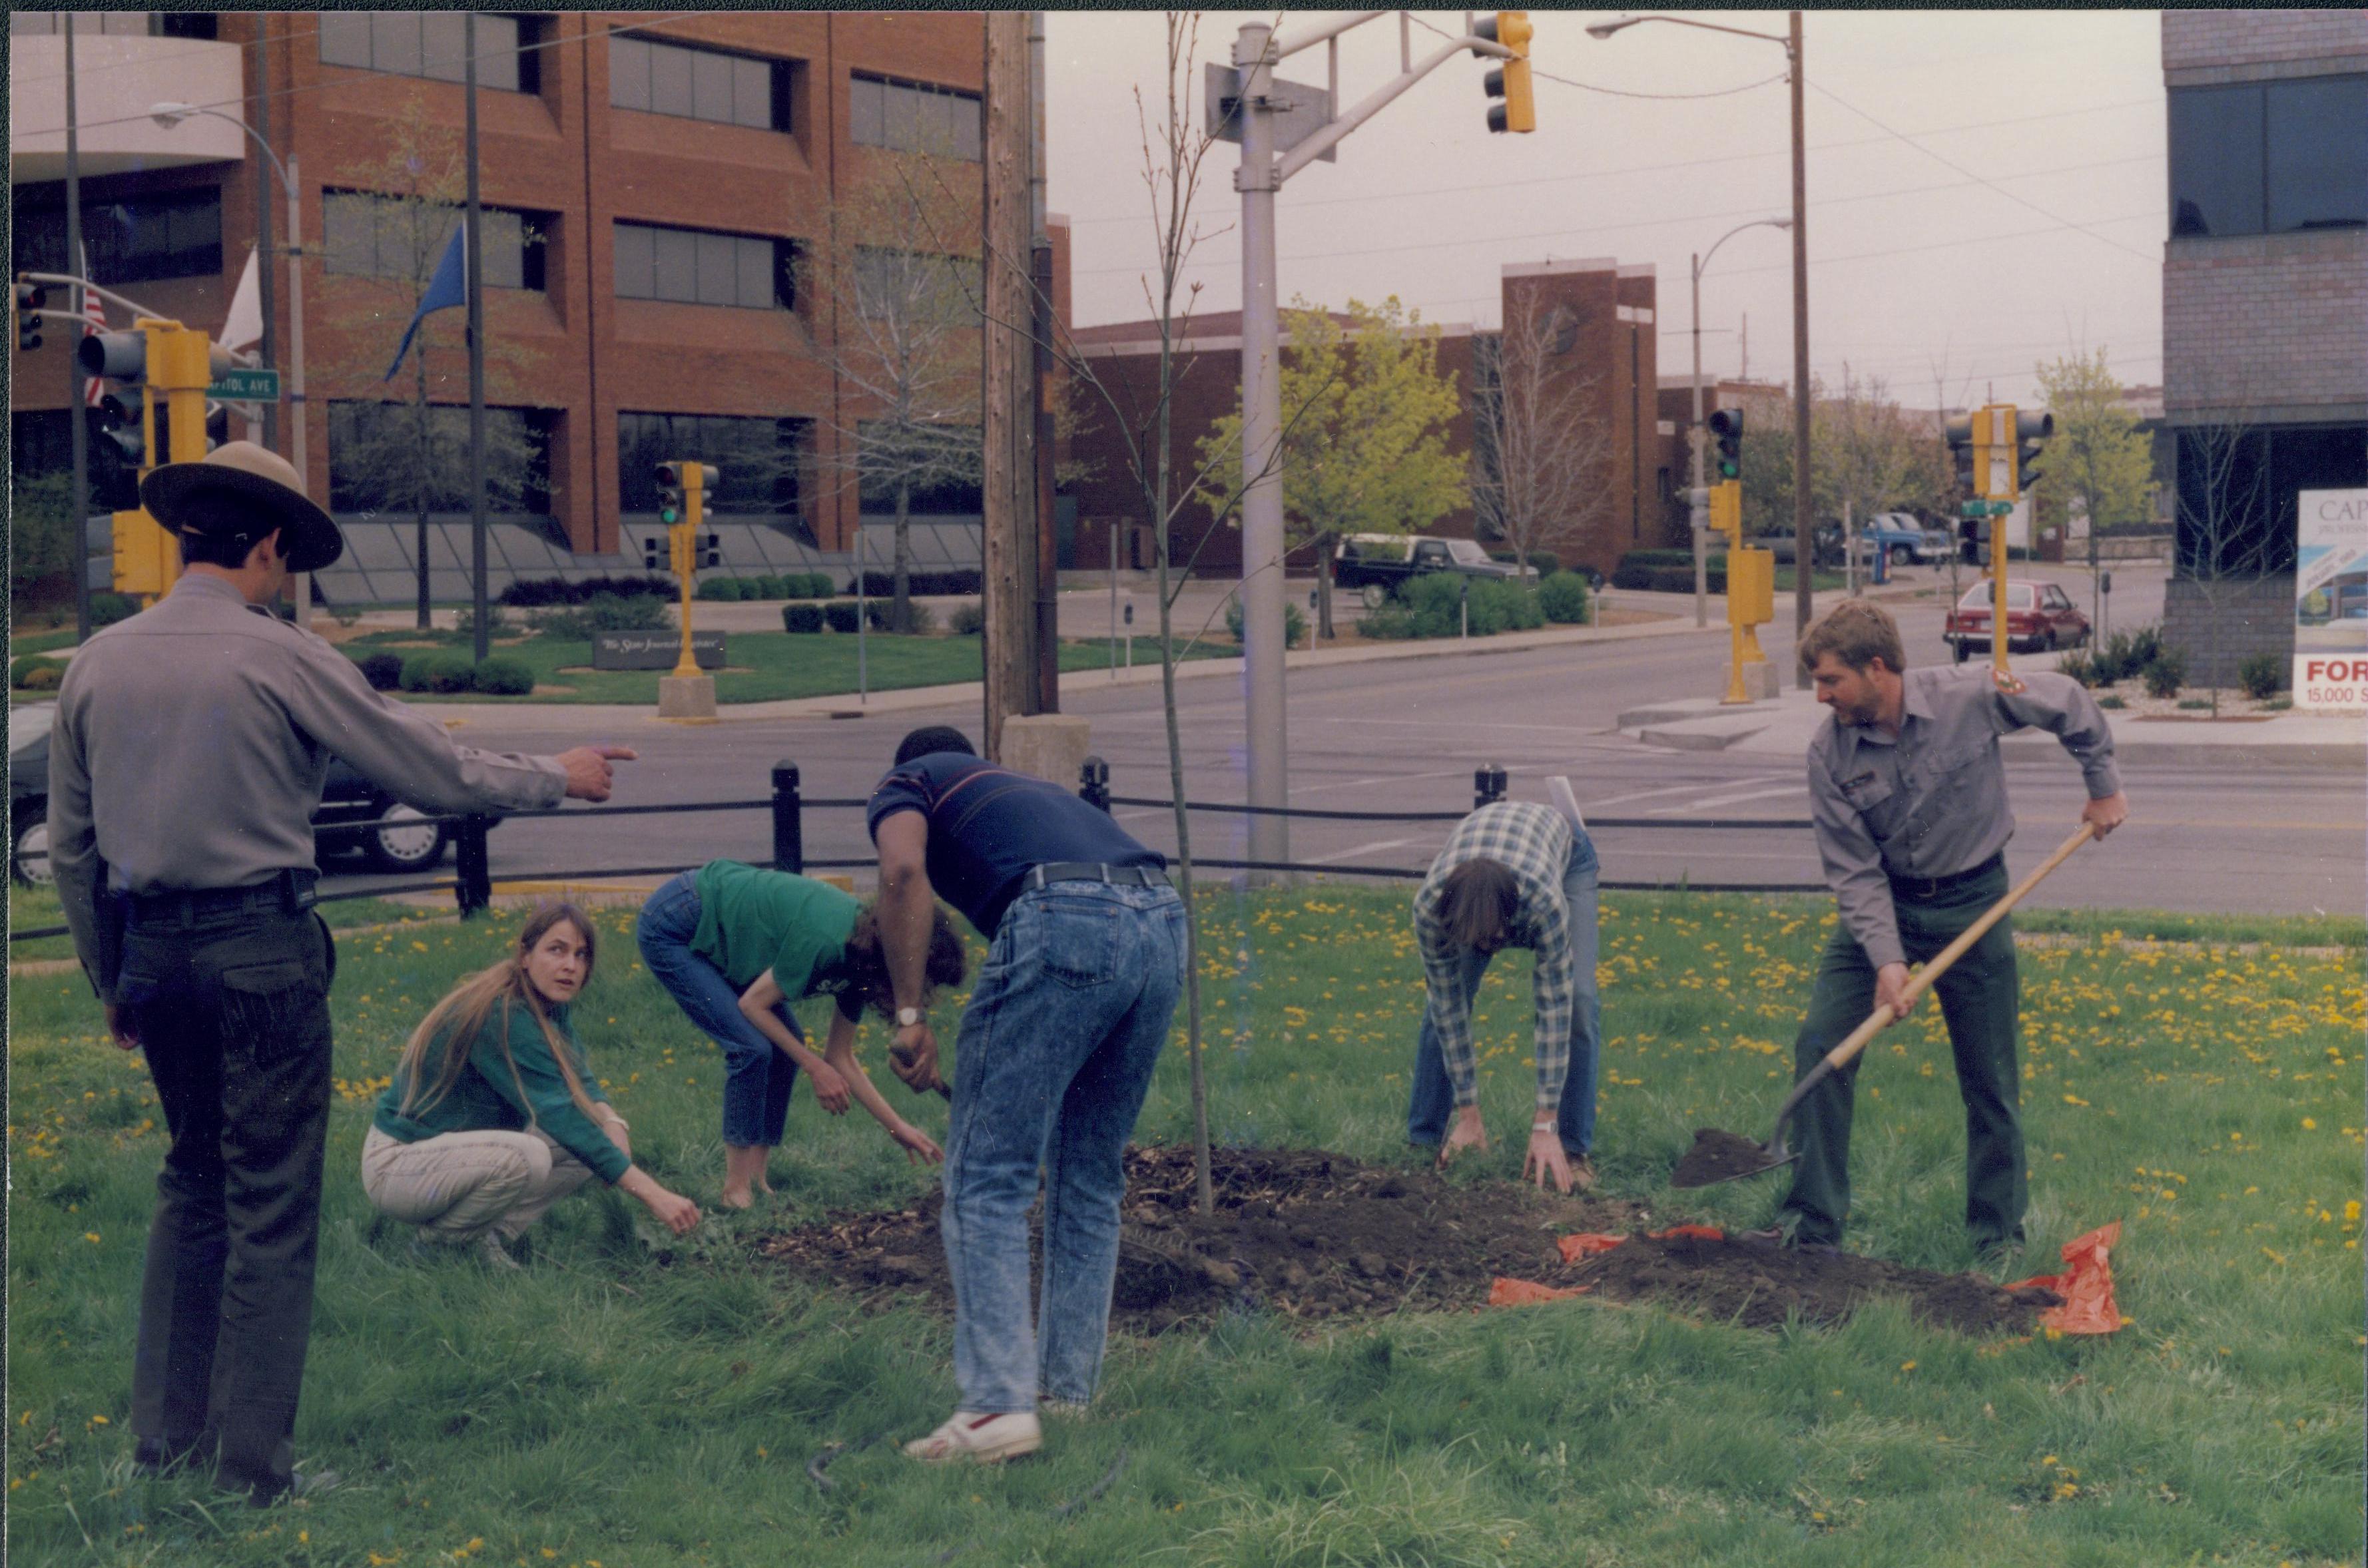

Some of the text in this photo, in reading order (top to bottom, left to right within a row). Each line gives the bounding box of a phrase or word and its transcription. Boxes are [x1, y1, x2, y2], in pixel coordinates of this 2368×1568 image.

[250, 380, 270, 393] AVE
[2307, 660, 2367, 682] FOR
[2307, 687, 2353, 704] 15,000
